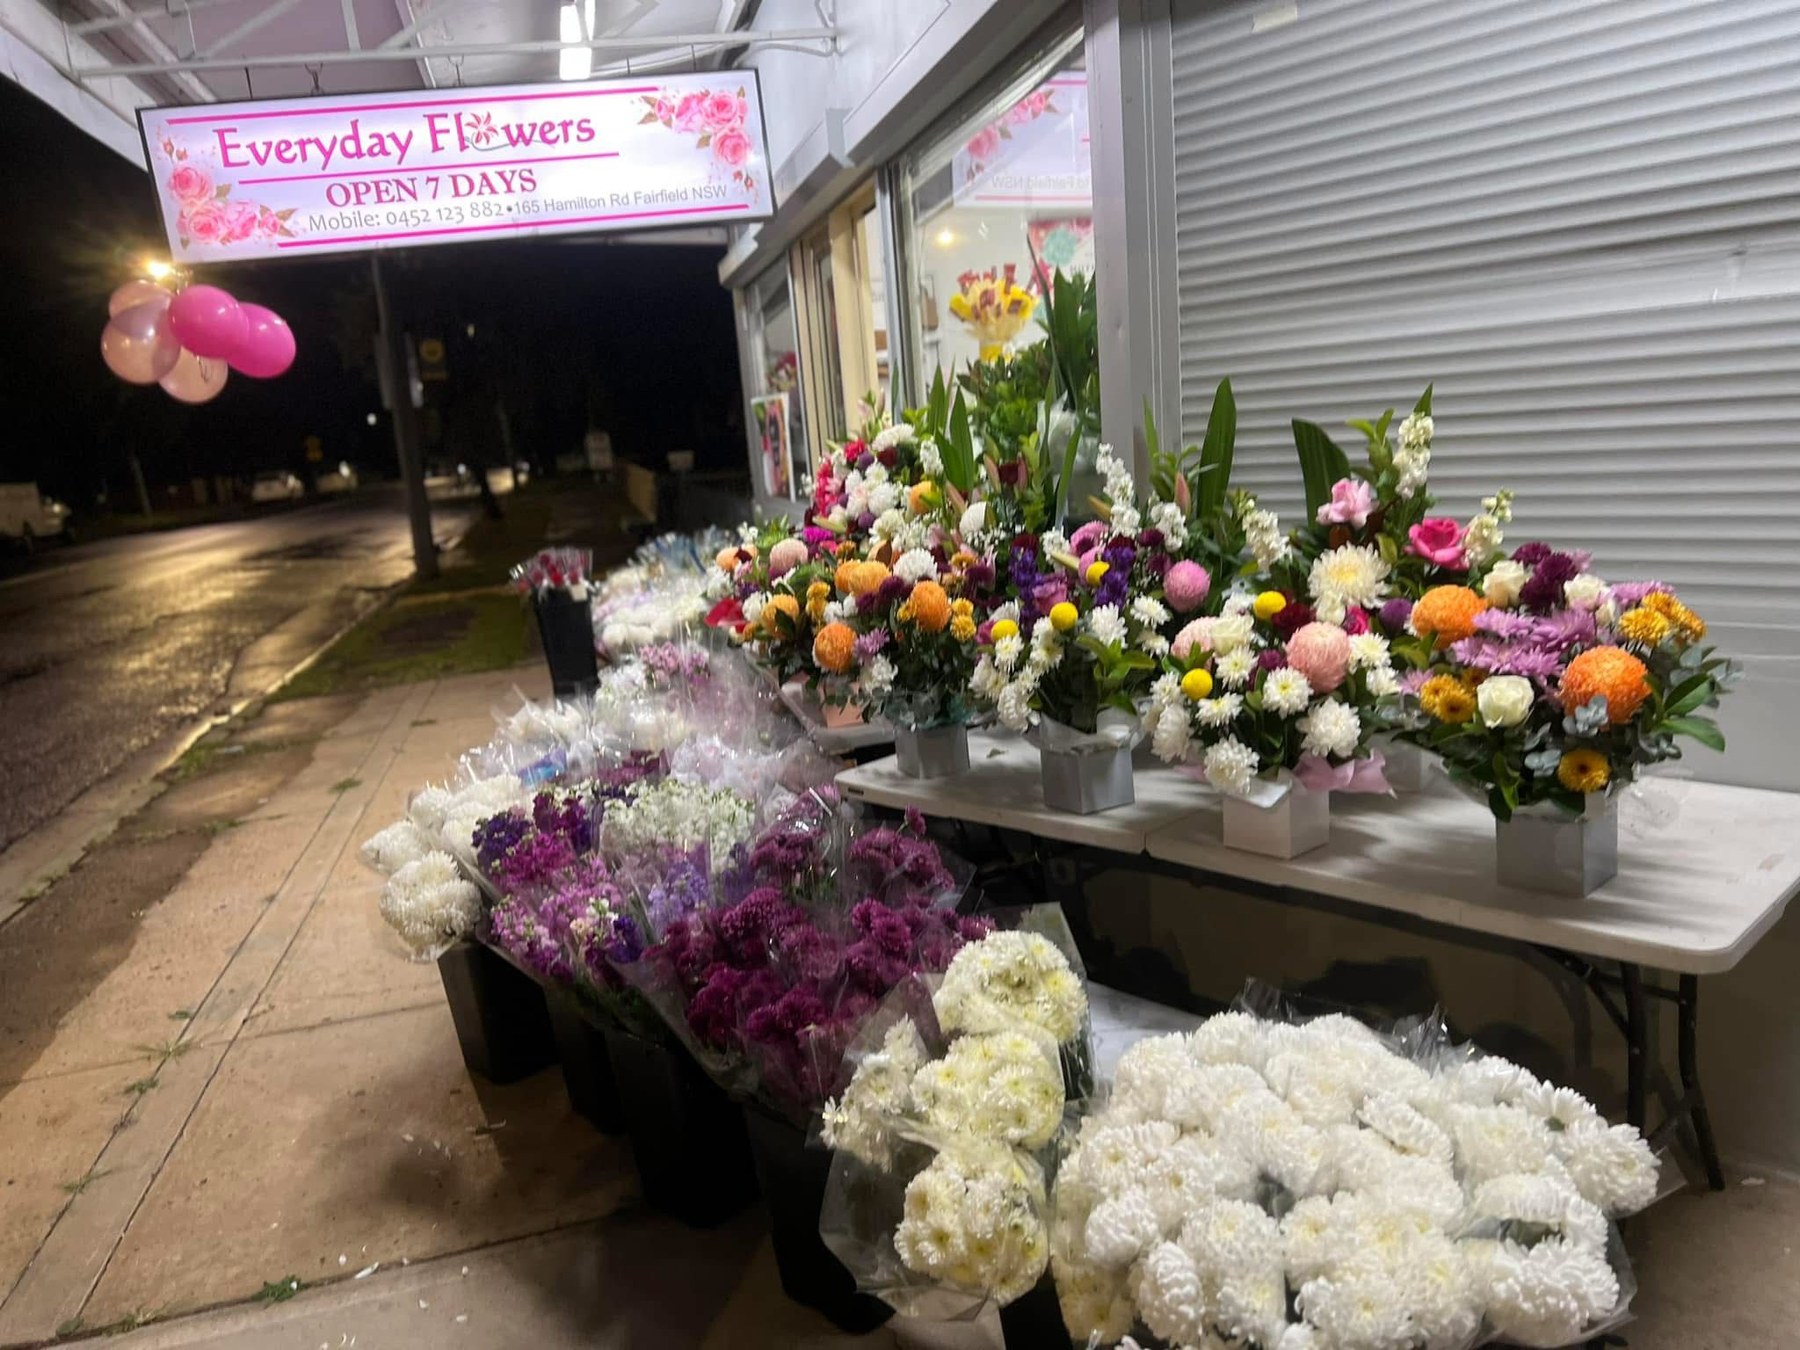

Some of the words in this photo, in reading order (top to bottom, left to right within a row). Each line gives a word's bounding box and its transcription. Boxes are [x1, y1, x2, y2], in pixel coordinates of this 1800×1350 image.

[212, 118, 413, 171] Everyday
[423, 111, 596, 154] Flowers
[309, 210, 381, 232] Mobile:
[386, 208, 431, 228] 0452
[437, 206, 465, 224] 123
[544, 194, 606, 213] Hamilton
[610, 193, 630, 207] Rd
[634, 187, 689, 205] Fairfield
[692, 184, 728, 200] NSW
[326, 177, 418, 208] OPEN
[425, 176, 440, 200] 7
[449, 168, 537, 198] DAYS
